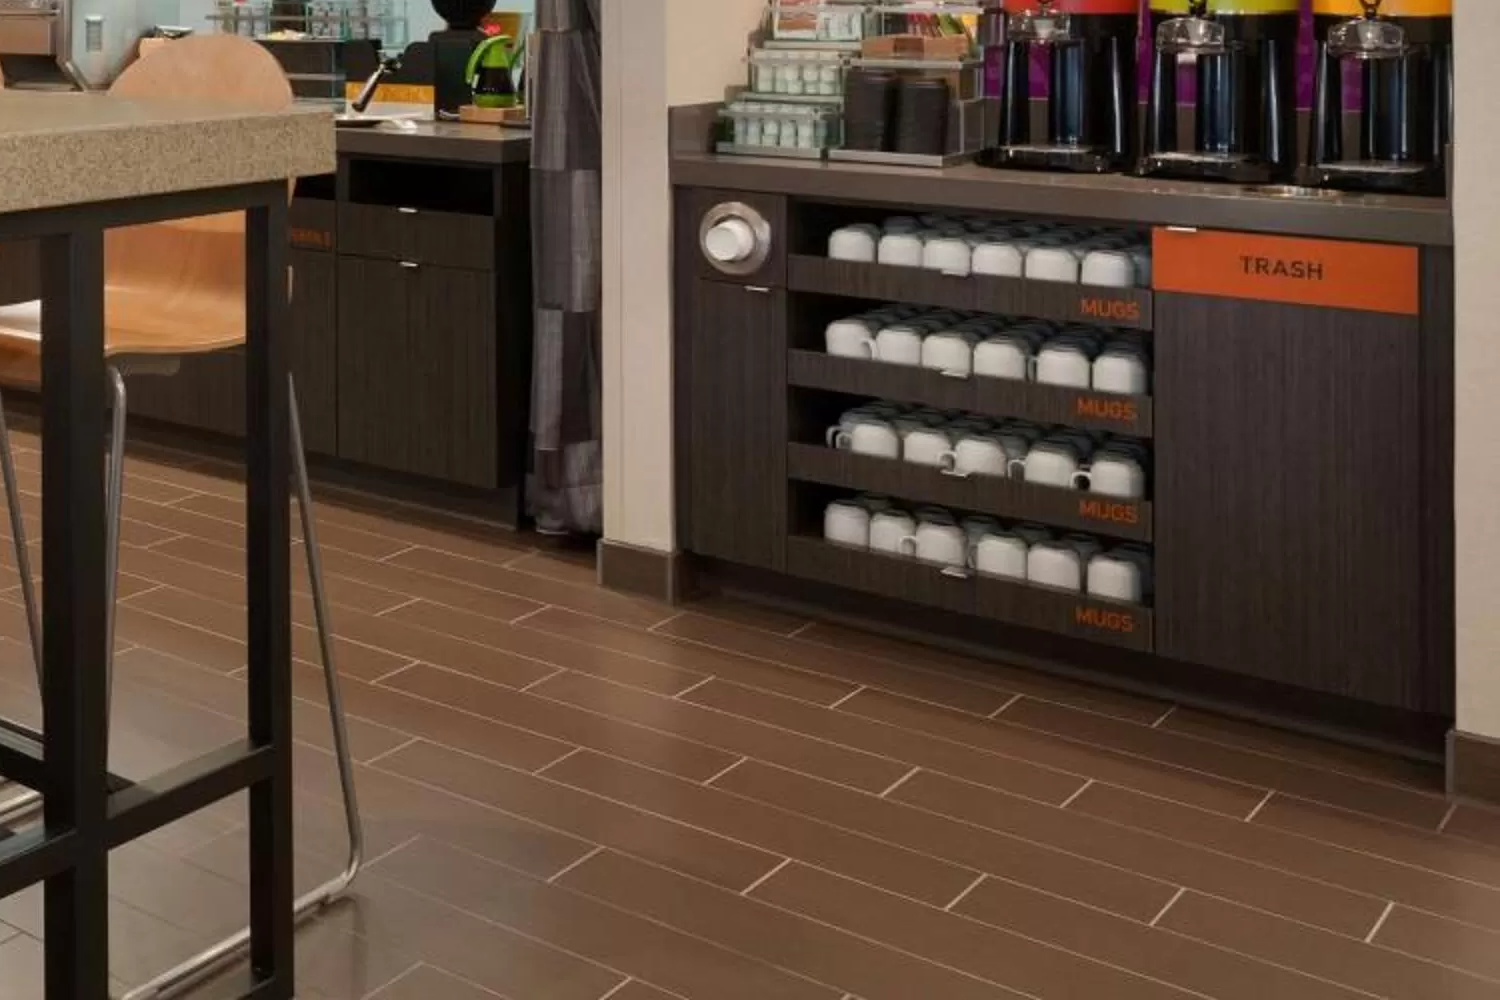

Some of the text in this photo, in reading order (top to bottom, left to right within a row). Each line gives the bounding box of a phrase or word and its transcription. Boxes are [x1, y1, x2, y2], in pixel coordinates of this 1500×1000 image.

[1239, 255, 1324, 281] TRASH
[1079, 297, 1142, 320] MUGS
[1076, 396, 1138, 422] MUGS
[1078, 499, 1139, 524] MUGS
[1074, 605, 1135, 633] MUGS
